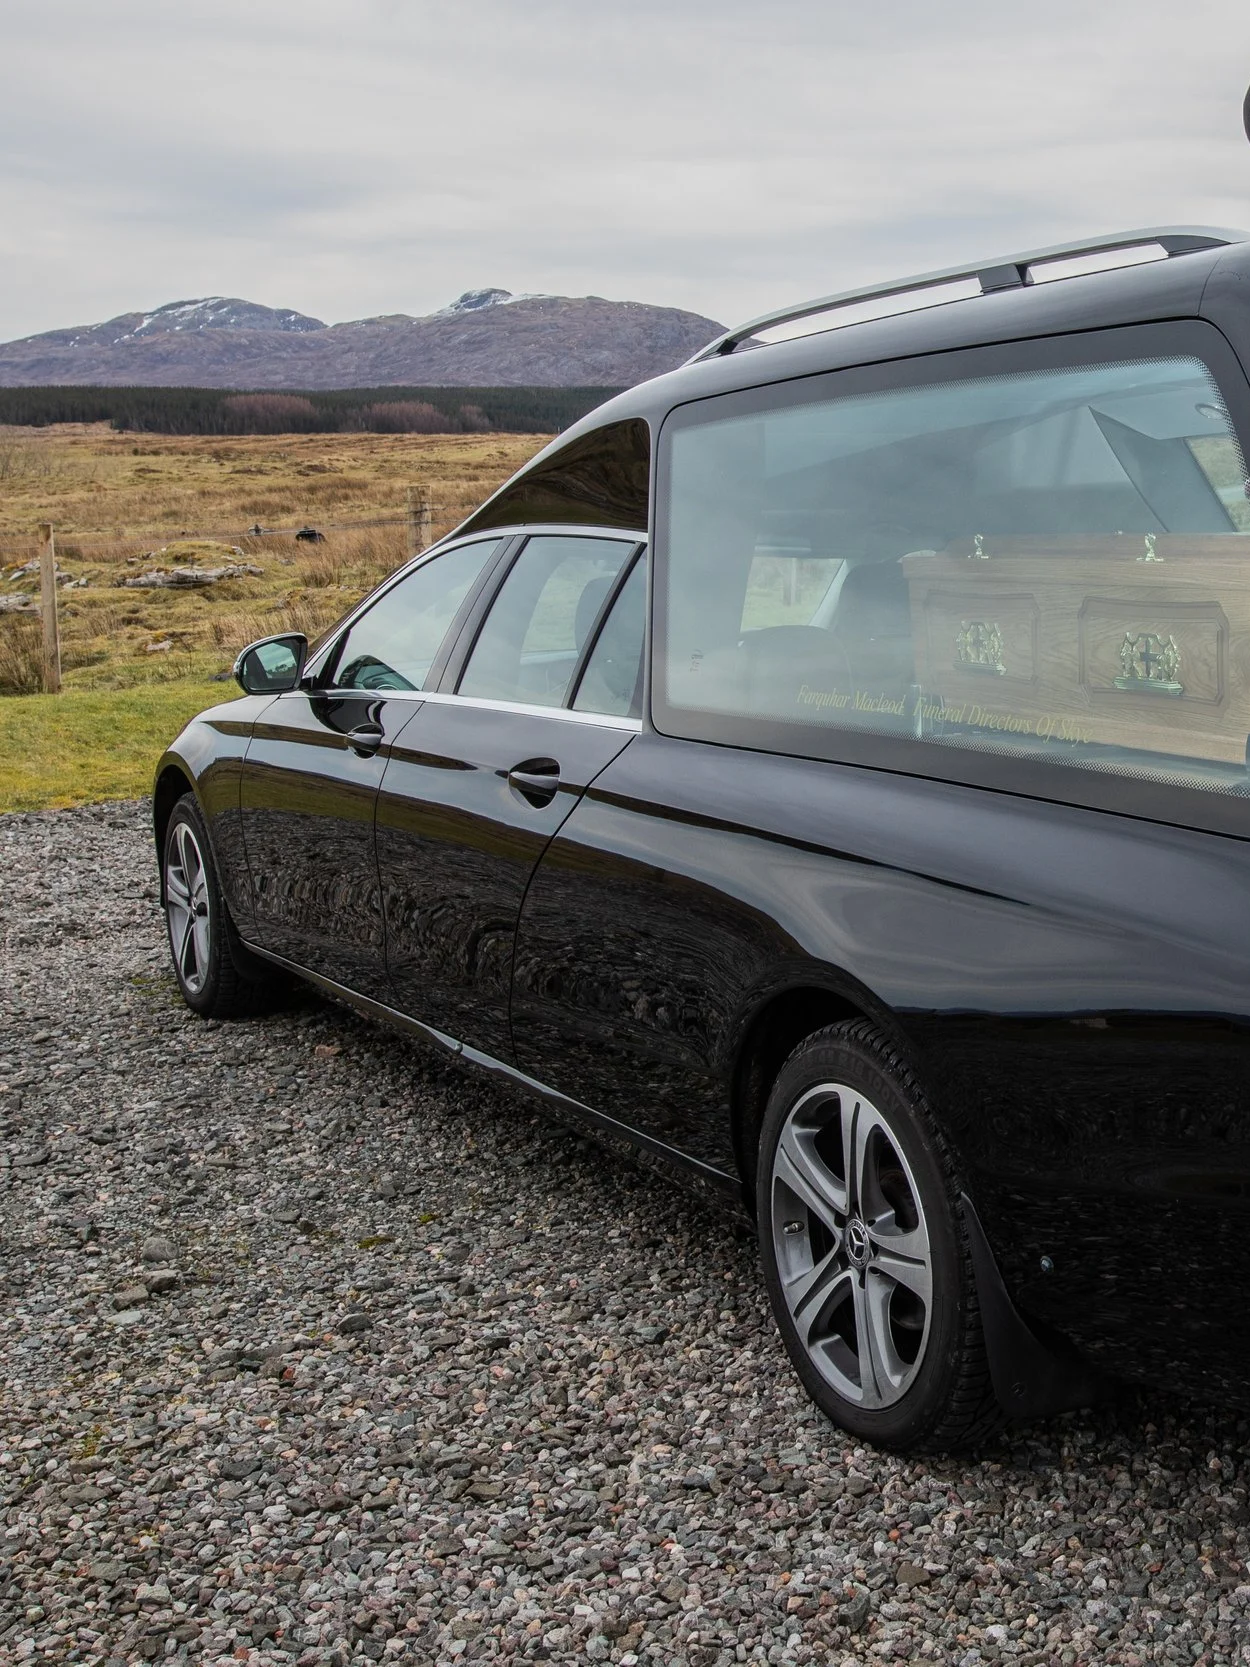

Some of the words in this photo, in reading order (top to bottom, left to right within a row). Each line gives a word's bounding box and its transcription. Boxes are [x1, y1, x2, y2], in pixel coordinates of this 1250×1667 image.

[797, 684, 850, 711] Farquhar
[913, 696, 967, 725] Funeral
[968, 704, 1033, 735] Directors
[1036, 714, 1059, 744] Of
[1058, 718, 1094, 748] Skye
